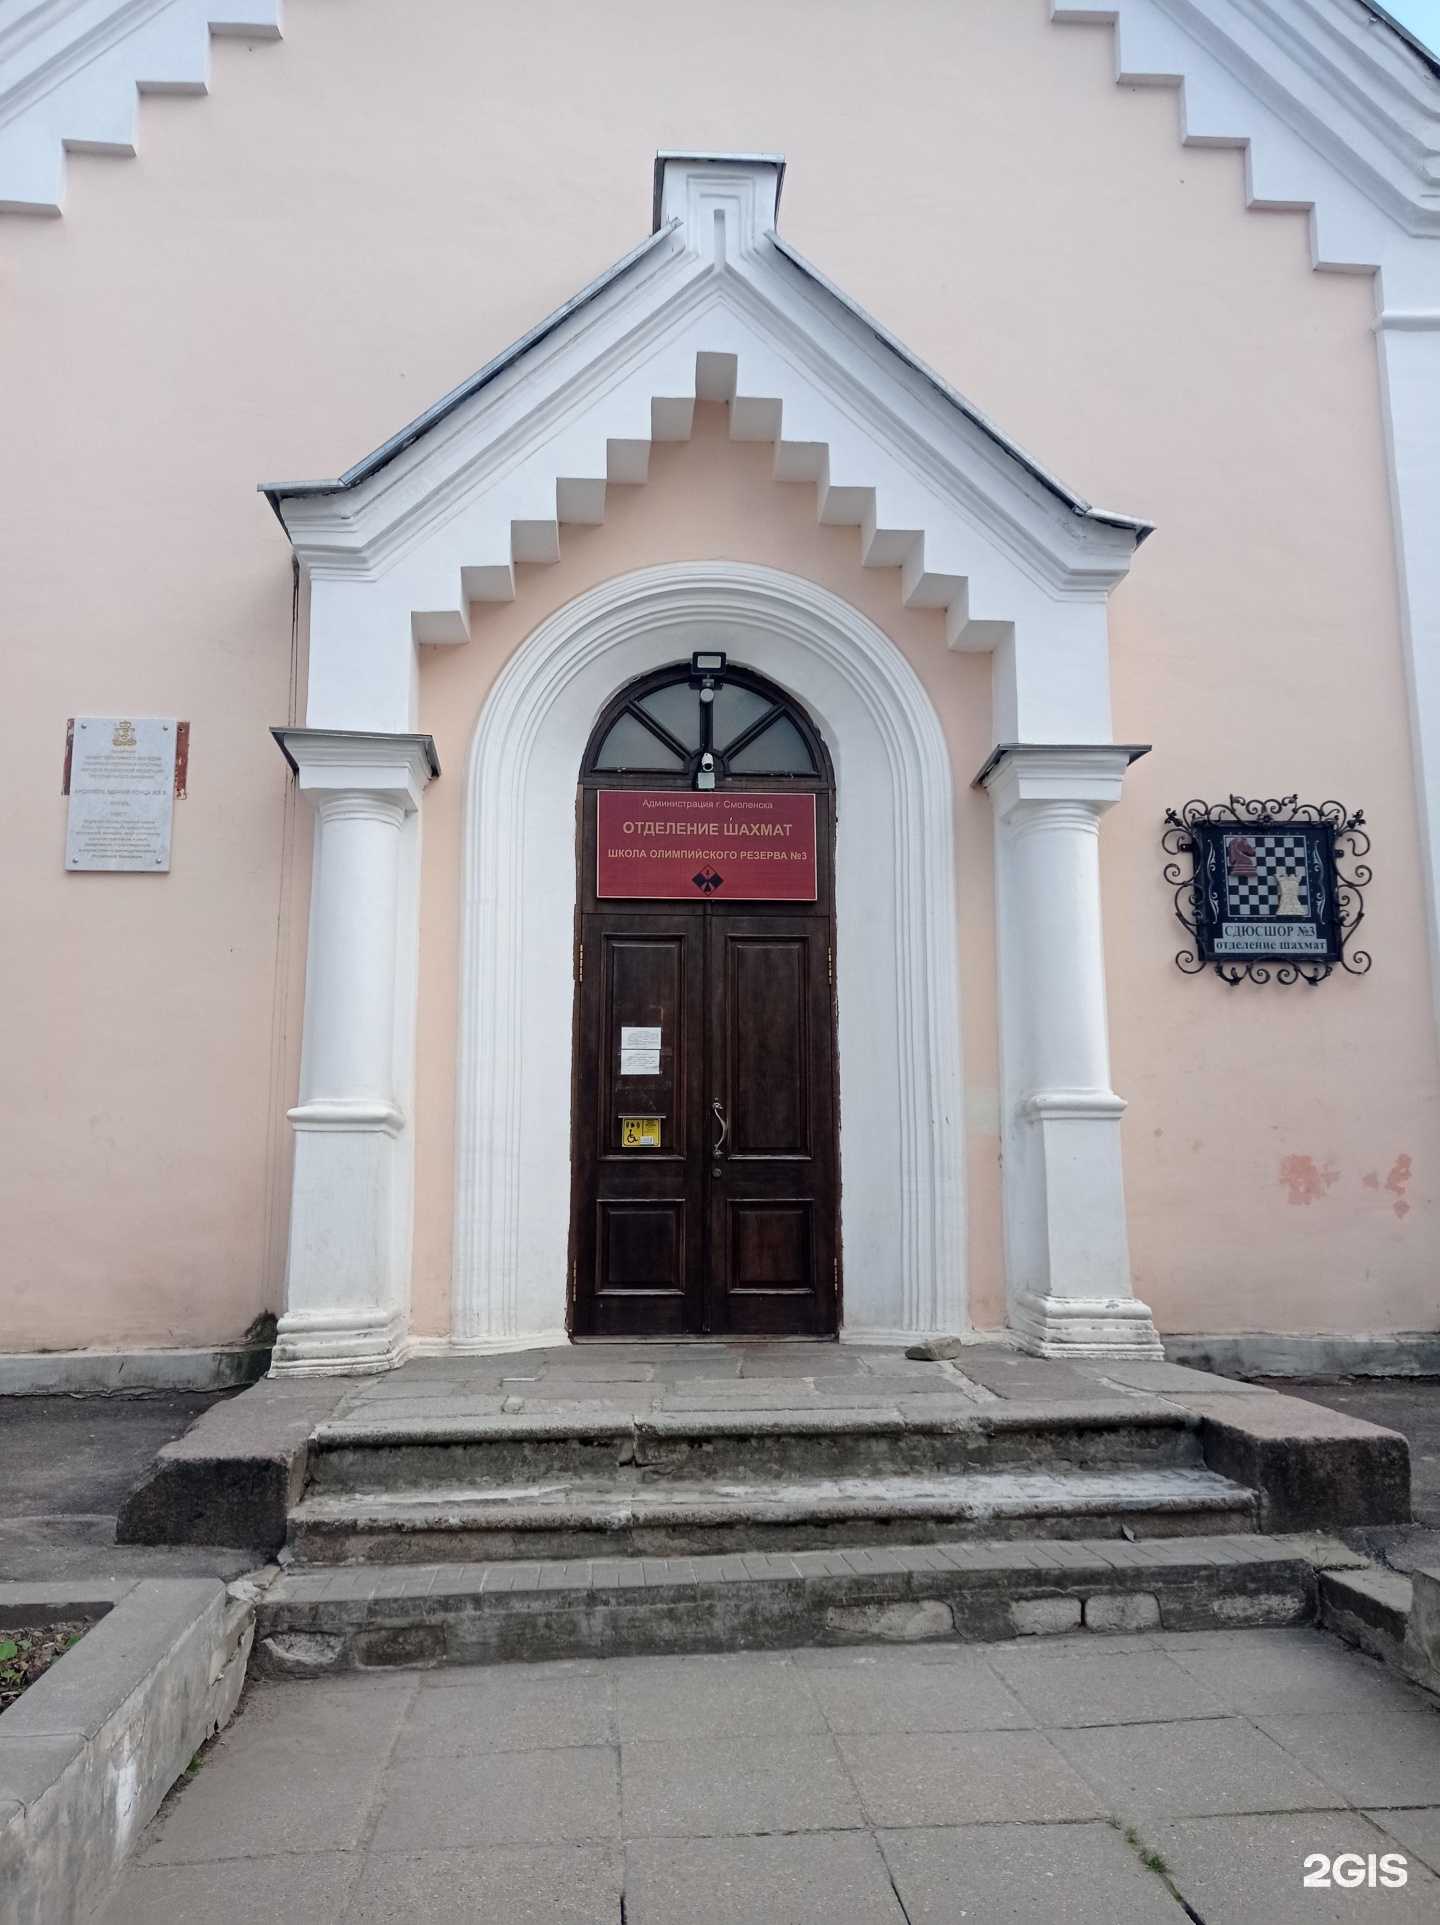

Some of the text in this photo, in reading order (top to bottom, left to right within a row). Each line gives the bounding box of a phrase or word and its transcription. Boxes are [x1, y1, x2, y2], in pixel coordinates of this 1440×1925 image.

[642, 799, 714, 809] Администрация
[723, 800, 774, 809] Смоленска
[622, 821, 793, 836] ОТДЕЛЕНИЕ ШАХМАТ
[607, 848, 808, 860] ШКОЛА ОЛИМПИЙСКОГО РЕЗЕРВА №3
[1224, 925, 1316, 937] СДЮСШОР №3
[1216, 941, 1326, 950] отделение шахмат
